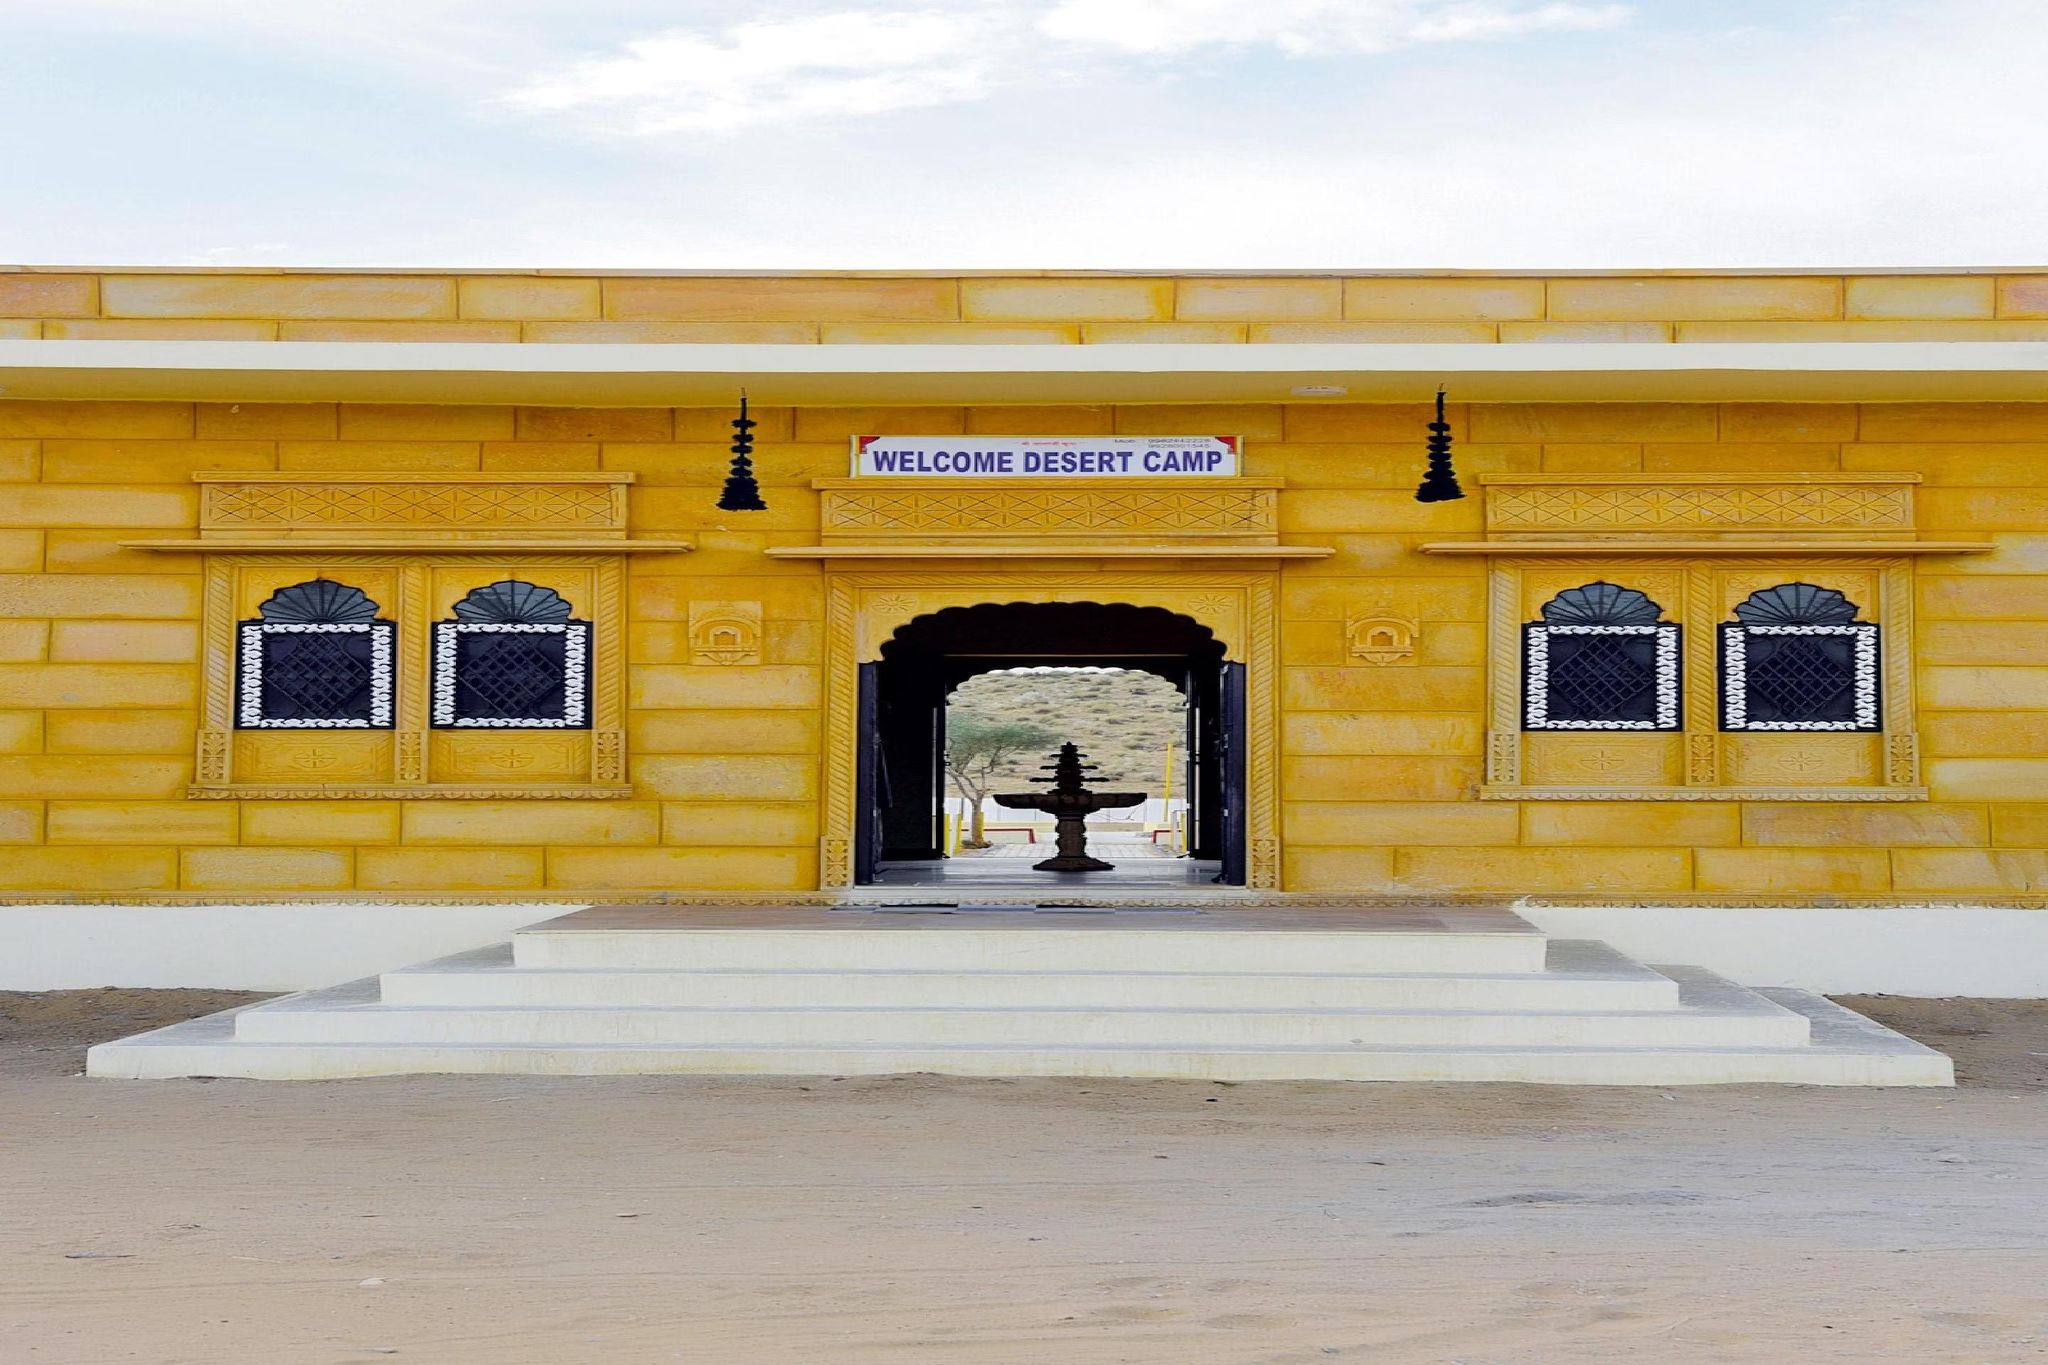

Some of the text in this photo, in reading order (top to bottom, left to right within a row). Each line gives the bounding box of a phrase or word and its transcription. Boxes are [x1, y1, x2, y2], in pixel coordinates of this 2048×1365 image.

[872, 450, 1222, 472] WELCOME DESERT CAMP
